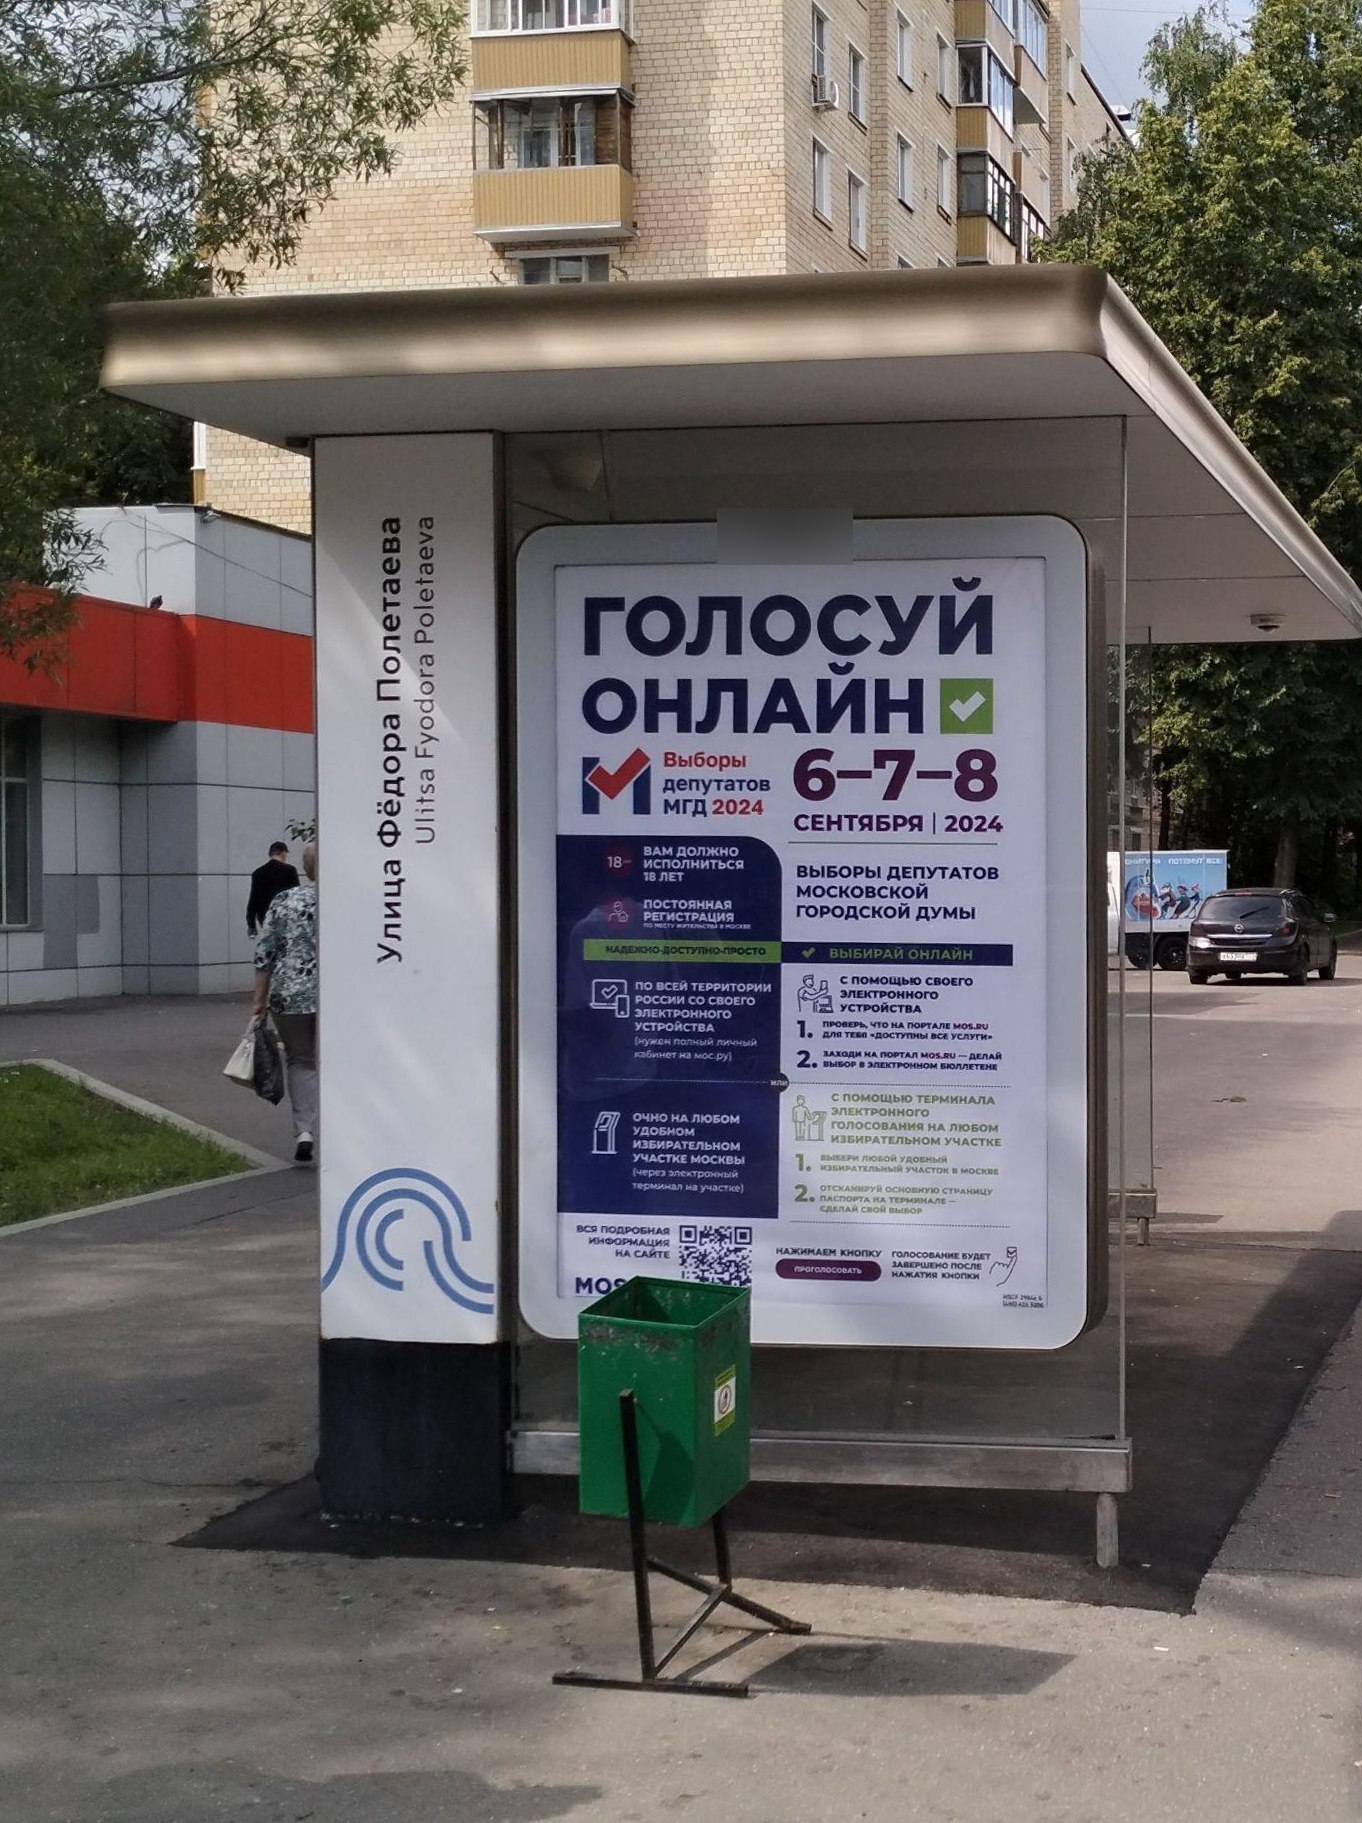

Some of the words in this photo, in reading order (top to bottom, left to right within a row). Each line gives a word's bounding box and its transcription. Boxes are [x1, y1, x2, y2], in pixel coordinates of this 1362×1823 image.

[414, 515, 435, 643] Poletaeva
[377, 517, 401, 703] Полетаева
[583, 576, 993, 657] ГОЛОСУЙ
[582, 662, 924, 735] ОНЛАЙН
[415, 654, 440, 759] Fyodora
[663, 752, 747, 770] Выборы
[377, 714, 406, 847] Фёдора
[662, 776, 771, 794] депутатов
[415, 769, 436, 845] Ulitsa
[664, 800, 706, 817] МГД
[712, 799, 763, 815] 2024
[794, 814, 923, 833] СЕНТЯБРЯ
[944, 815, 1003, 833] 2024
[644, 847, 673, 856] ВАМ
[676, 847, 738, 857] ДОЛЖНО
[644, 860, 744, 869] ИСПОЛНИТЬСЯ
[644, 872, 655, 881] 18
[659, 872, 684, 882] ЛЕТ
[797, 866, 881, 879] ВЫБОРЫ
[887, 867, 999, 881] ДЕПУТАТОВ
[797, 884, 928, 899] МОСКОВСКОЙ
[644, 900, 732, 909] ПОСТОЯННАЯ
[377, 858, 406, 965] Улица
[797, 903, 910, 920] ГОРОДСКОЙ
[916, 907, 975, 921] ДУМЫ
[644, 912, 734, 923] РЕГИСТРАЦИЯ
[829, 946, 904, 959] ВЫБИРАЙ
[908, 947, 973, 960] ОНЛАЙН
[635, 983, 652, 991] ПО
[657, 980, 688, 991] ВСЕЙ
[692, 983, 771, 993] ТЕРРИТОРИИ
[840, 976, 848, 985] С
[852, 976, 921, 987] ПОМОЩЬЮ
[925, 977, 973, 986] СВОЕГО
[840, 990, 938, 1000] ЭЛЕКТРОННОГО
[635, 996, 684, 1005] РОССИИ
[688, 997, 705, 1005] СО
[709, 997, 755, 1006] СВОЕГО
[840, 1002, 921, 1013] УСТРОЙСТВА
[635, 1009, 732, 1019] ЭЛЕКТРОННОГО
[635, 1021, 715, 1032] УСТРОЙСТВА
[797, 1020, 813, 1038] 1.
[823, 1021, 868, 1030] ПРОВЕРЬ,
[907, 1022, 951, 1030] ПОРТАЛЕ
[635, 1037, 671, 1046] (нужен
[674, 1037, 713, 1046] полный
[716, 1038, 757, 1047] личный
[635, 1051, 676, 1059] кабинет
[797, 1051, 817, 1068] 2.
[969, 1051, 1002, 1061] ДЕЛАЙ
[940, 1062, 997, 1070] БЮЛЛЕТЕНЕ
[843, 1094, 912, 1104] ПОМОЩЬЮ
[917, 1095, 995, 1104] ТЕРМИНАЛА
[832, 1108, 929, 1117] ЭЛЕКТРОННОГО
[633, 1113, 668, 1122] ОЧНО
[671, 1114, 688, 1122] НА
[692, 1115, 740, 1124] ЛЮБОМ
[633, 1127, 694, 1137] УДОБНОМ
[831, 1122, 924, 1131] ГОЛОСОВАНИЯ
[928, 1123, 945, 1132] НА
[949, 1123, 998, 1133] ЛЮБОМ
[633, 1140, 740, 1150] ИЗБИРАТЕЛЬНОМ
[831, 1135, 940, 1145] ИЗБИРАТЕЛЬНОМ
[944, 1137, 1001, 1146] УЧАСТКЕ
[633, 1154, 687, 1163] УЧАСТКЕ
[690, 1155, 744, 1165] МОСКВЫ
[796, 1154, 811, 1171] 1.
[820, 1154, 859, 1162] ВЫБЕРИ
[862, 1154, 897, 1162] ЛЮБОЙ
[900, 1154, 947, 1163] УДОБНЫЙ
[633, 1169, 666, 1178] (через
[669, 1170, 737, 1178] электронный
[820, 1164, 902, 1173] ИЗБИРАТЕЛЬНЫЙ
[905, 1166, 949, 1174] УЧАСТОК
[961, 1167, 999, 1175] МОСКВЕ
[633, 1183, 683, 1191] терминал
[700, 1185, 743, 1194] участке)
[794, 1185, 815, 1202] 2.
[820, 1184, 882, 1193] ОТСКАНИРУЙ
[886, 1186, 939, 1194] ОСНОВНУЮ
[942, 1188, 993, 1196] СТРАНИЦУ
[820, 1195, 870, 1203] ПАСПОРТА
[889, 1196, 946, 1204] ТЕРМИНАЛЕ
[820, 1204, 858, 1214] СДЕЛАЙ
[861, 1205, 886, 1213] СВОЙ
[577, 1225, 598, 1233] ВСЯ
[601, 1226, 670, 1235] ПОДРОБНАЯ
[589, 1238, 670, 1247] ИНФОРМАЦИЯ
[634, 1249, 670, 1259] САЙТЕ
[776, 1248, 836, 1257] НАЖИМАЕМ
[840, 1249, 882, 1258] КНОПКУ
[892, 1251, 959, 1259] ГОЛОСОВАНИЕ
[794, 1266, 862, 1274] ПРОГОЛОСОВАТЬ
[892, 1261, 948, 1269] ЗАВЕРШЕНО
[951, 1262, 982, 1270] ПОСЛЕ
[892, 1271, 938, 1279] НАЖАТИЯ
